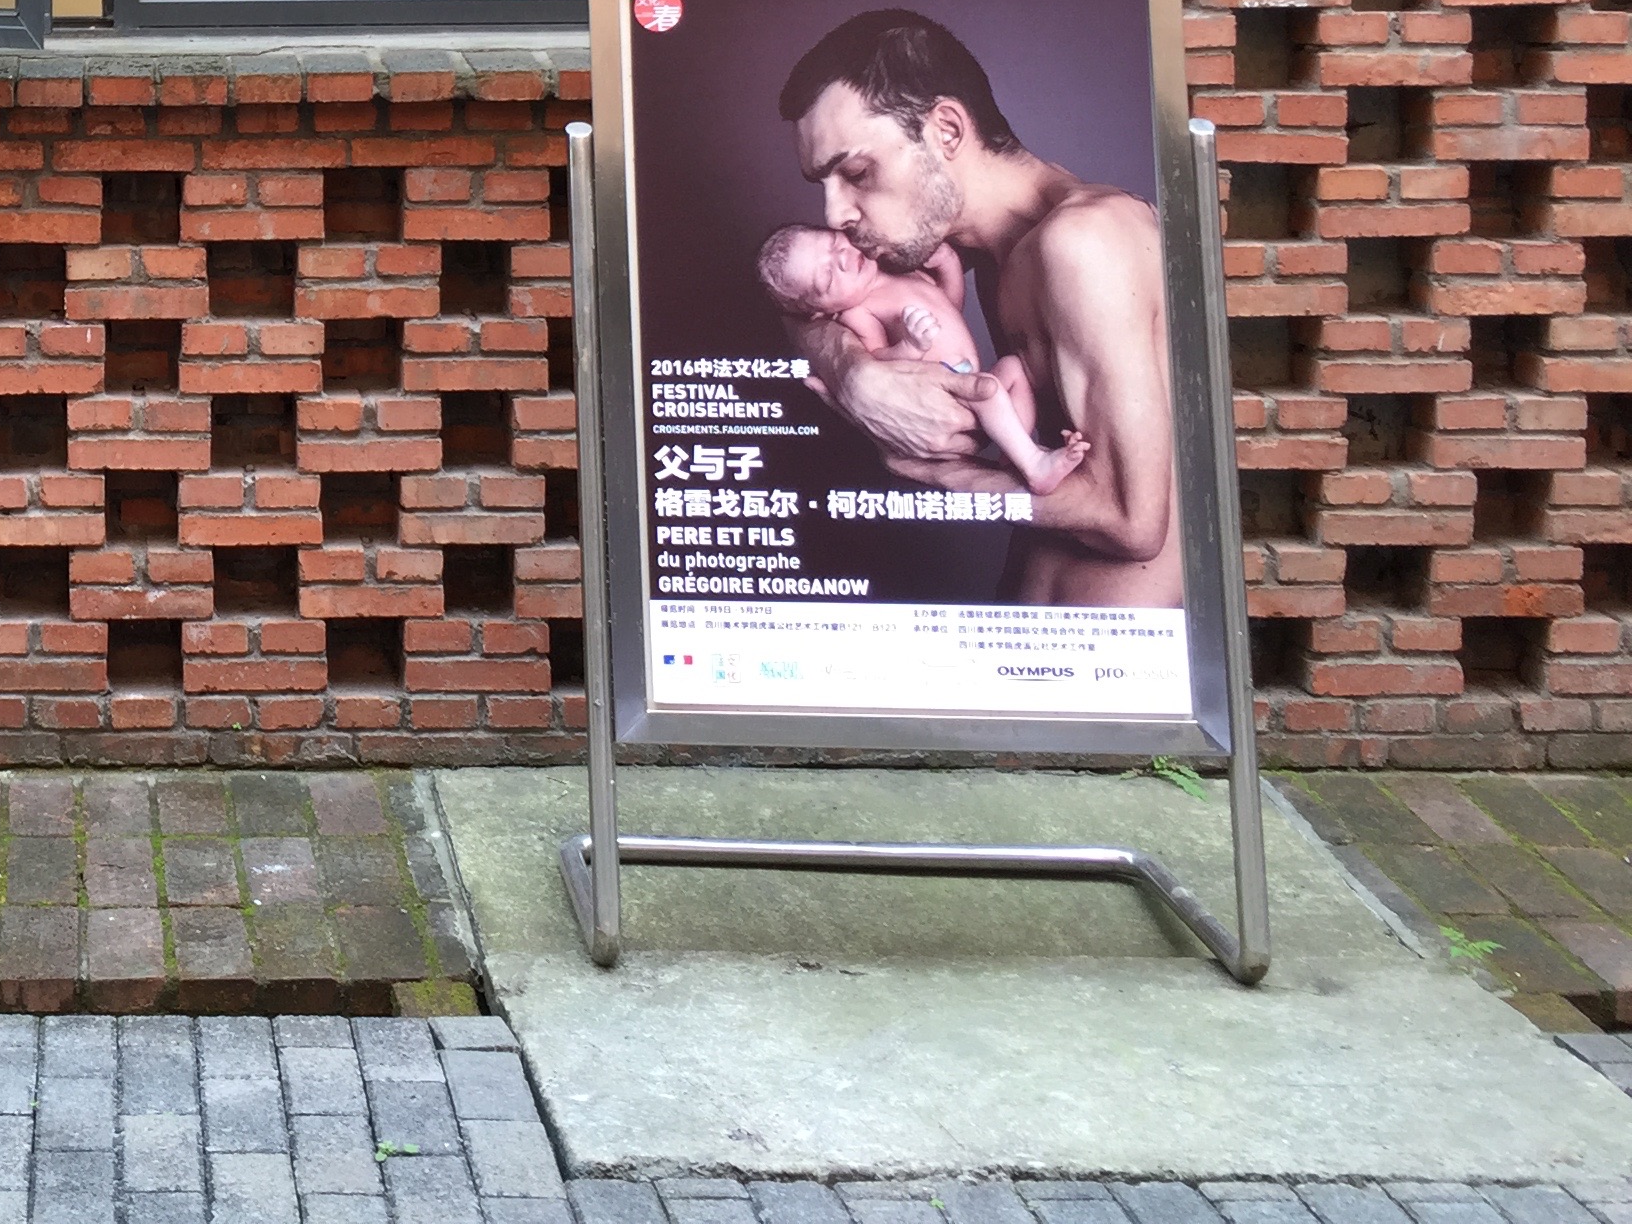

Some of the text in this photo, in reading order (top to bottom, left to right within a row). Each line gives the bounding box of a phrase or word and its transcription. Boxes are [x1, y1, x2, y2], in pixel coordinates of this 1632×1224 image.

[651, 358, 810, 378] 2016中法文化之春
[652, 384, 739, 400] FESTIVAL
[652, 402, 783, 418] CROISEMENTS
[653, 424, 820, 436] CROISEMENTS.FAGUOWENHUA.COM
[653, 444, 764, 480] 父与子
[657, 527, 795, 546] PERE ET FILS
[657, 552, 800, 573] du photographe
[658, 571, 870, 595] GRÉGOIRE KORGANOW
[997, 665, 1075, 678] OLYMPUS
